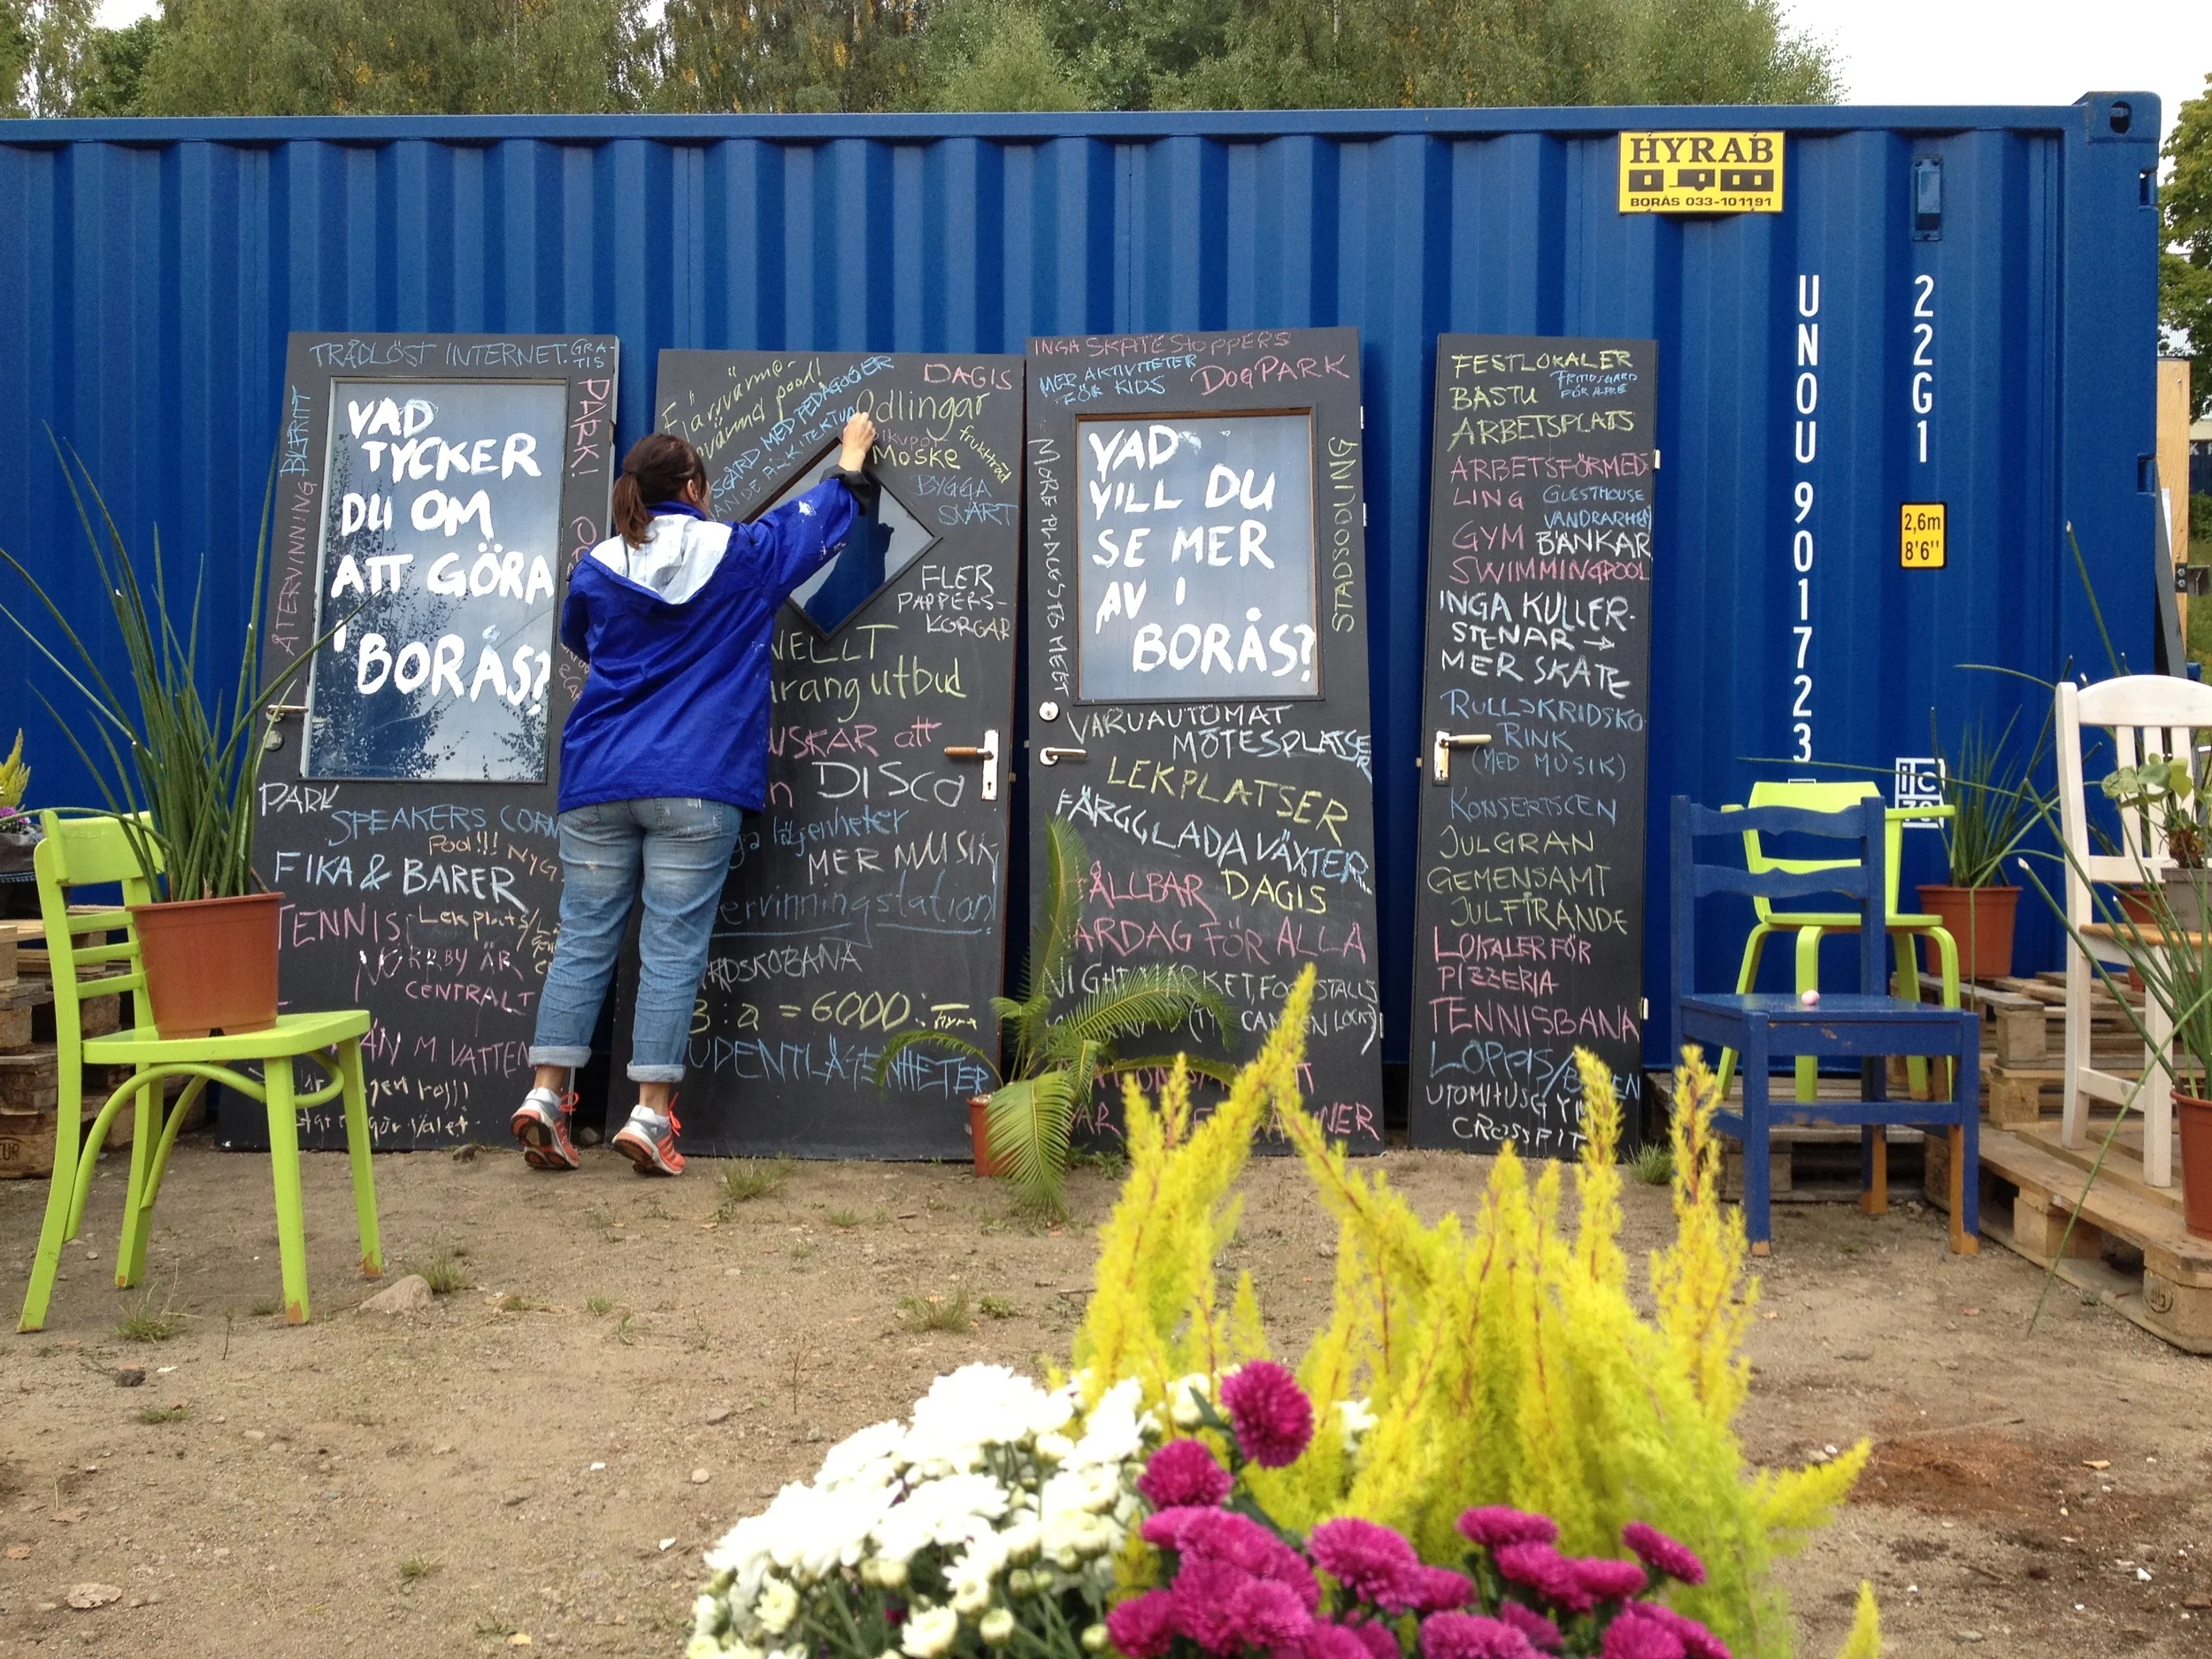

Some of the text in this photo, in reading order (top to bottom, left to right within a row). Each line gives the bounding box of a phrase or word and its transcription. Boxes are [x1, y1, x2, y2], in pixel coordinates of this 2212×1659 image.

[1630, 137, 1774, 164] HYRAB
[1631, 196, 1771, 207] BORÅS 033-101191
[309, 339, 567, 368] TRÅDLÖST INTERNET.
[573, 355, 604, 369] TIS
[1034, 338, 1080, 356] INGA
[1450, 349, 1633, 379] FESTLOKALER
[924, 363, 1013, 390] DAGIS
[1039, 372, 1078, 397] MER
[1115, 374, 1166, 397] KIDS
[1794, 274, 1819, 463] UNOU
[1912, 274, 1934, 463] 22G1
[856, 388, 991, 441] Odlingar
[1449, 385, 1539, 411] BASTU
[348, 397, 439, 439] VAD
[569, 378, 611, 479] PARK!
[760, 418, 795, 451] MED
[1447, 410, 1635, 452] ARBETSPLATS
[361, 433, 542, 484] TYCKER
[872, 444, 961, 470] Moske
[1027, 438, 1061, 507] MORE
[1088, 425, 1179, 482] VAD
[1089, 463, 1276, 521] VILL DU
[1453, 487, 1525, 510] LING
[1543, 484, 1645, 503] GUESTHOUSE
[342, 488, 495, 541] DU OM
[1328, 436, 1359, 632] STADSODLING
[1904, 512, 1941, 534] 2,6m
[1092, 519, 1276, 570] SE MER
[1452, 520, 1525, 551] GYM
[1535, 528, 1653, 561] BÄNKAR
[331, 554, 415, 599] ATT
[427, 542, 554, 604] GÖRA
[921, 565, 995, 594] FLER
[1449, 556, 1651, 585] SWIMMINGPOOL
[1095, 576, 1187, 635] AV I
[1440, 588, 1513, 623] INGA
[926, 614, 1011, 641] KORGAR
[1133, 607, 1316, 682] BORÅS?
[1452, 620, 1576, 651] STENAR
[357, 625, 550, 715] BORÅS?
[870, 655, 967, 699] utbud
[1441, 649, 1632, 699] MER SKATE
[1066, 704, 1293, 744] VARUAUTOMAT
[1440, 688, 1644, 732] RULLSKRIDSKO
[894, 716, 943, 749] att
[1496, 721, 1573, 753] RINK
[1472, 745, 1626, 783] (MED MUSIK)
[258, 782, 340, 817] PARK
[1107, 757, 1349, 847] LEKPLATSER
[1450, 786, 1617, 826] KONSERTSCEN
[326, 803, 561, 847] SPEAKERS CORN
[1056, 785, 1373, 895] FÄRGGLADA VÄXTER
[1440, 825, 1594, 859] JULGRAN
[807, 830, 999, 885] MER MUSIK
[274, 850, 530, 915] FIKA & BARER
[1220, 869, 1327, 915] DAGIS
[1427, 864, 1611, 897] GEMENSAMT
[1200, 917, 1270, 965] FÖR
[1278, 916, 1366, 964] ALLA
[1434, 926, 1593, 965] LOKALER FÖR
[405, 980, 536, 1017] CENTRALT
[1437, 963, 1560, 998] PIZZERIA
[1429, 996, 1640, 1043] TENNISBANA
